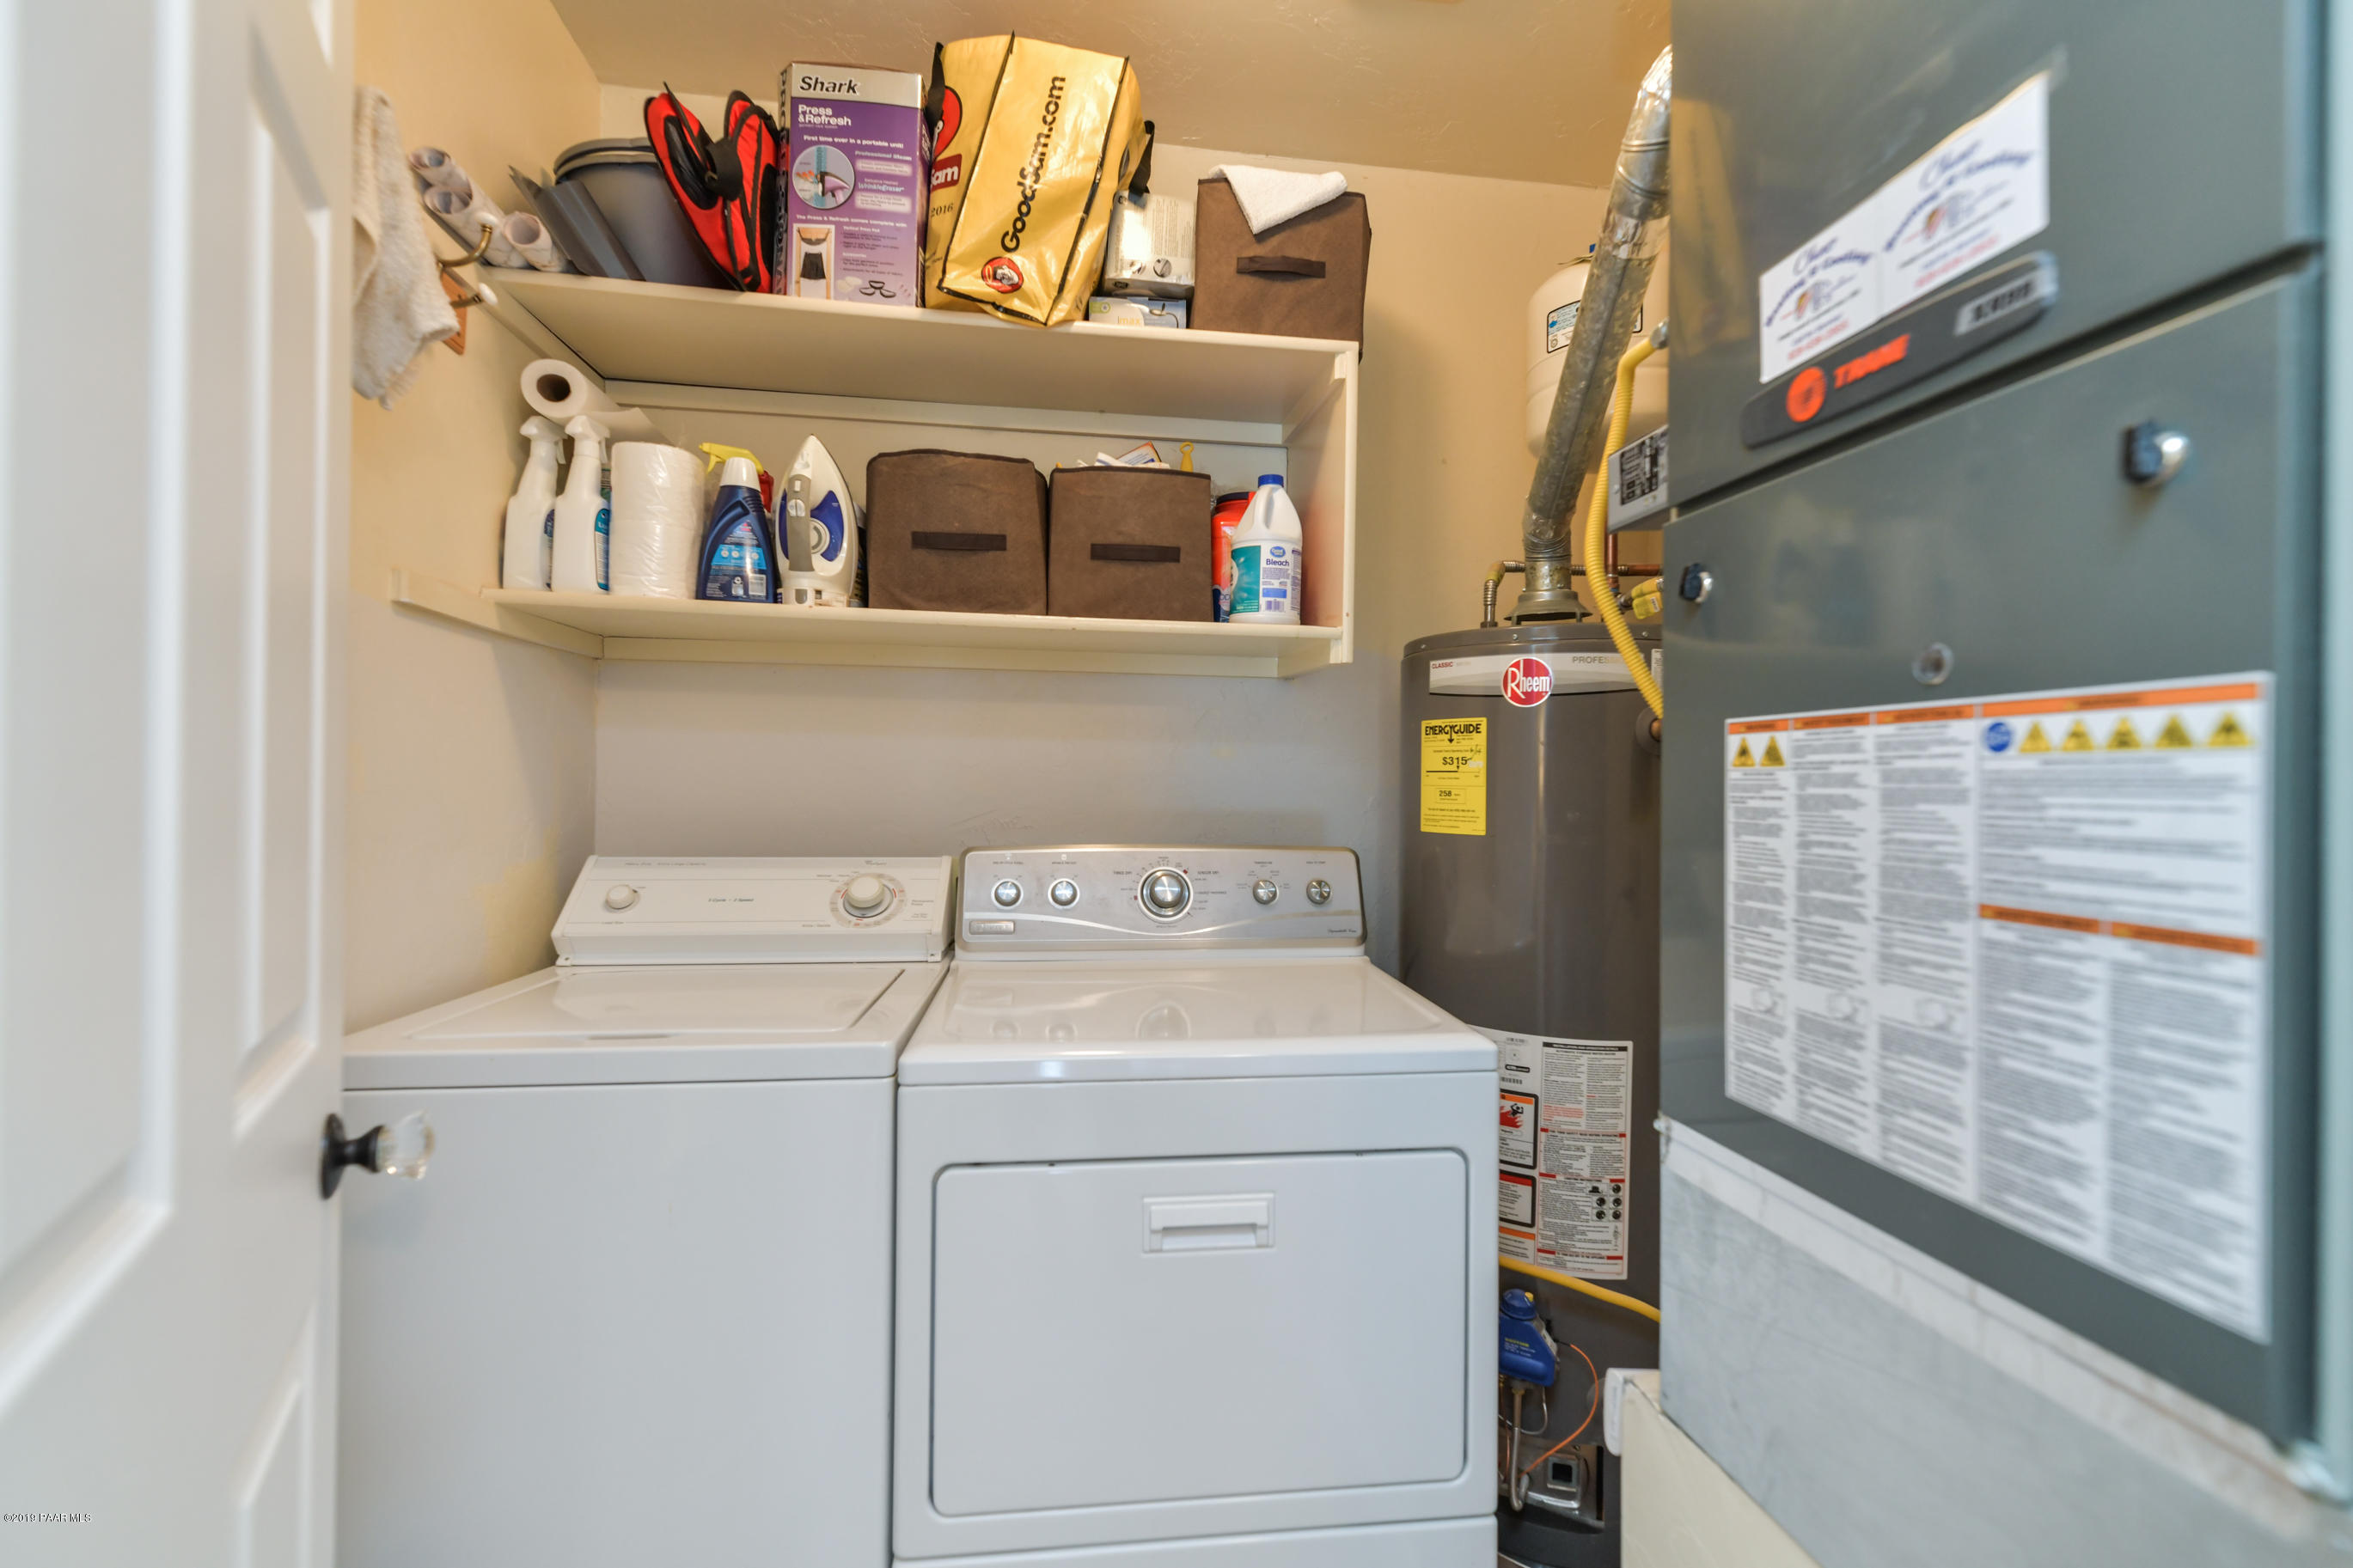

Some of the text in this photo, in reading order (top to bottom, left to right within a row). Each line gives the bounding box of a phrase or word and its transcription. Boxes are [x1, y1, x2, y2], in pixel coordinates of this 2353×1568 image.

[799, 76, 858, 95] Shark
[798, 104, 833, 116] Press
[1001, 76, 1066, 253] GoodSam.com
[932, 203, 954, 216] 2016
[1507, 659, 1550, 699] Rheem
[1425, 723, 1482, 736] ENERGYGUIDE
